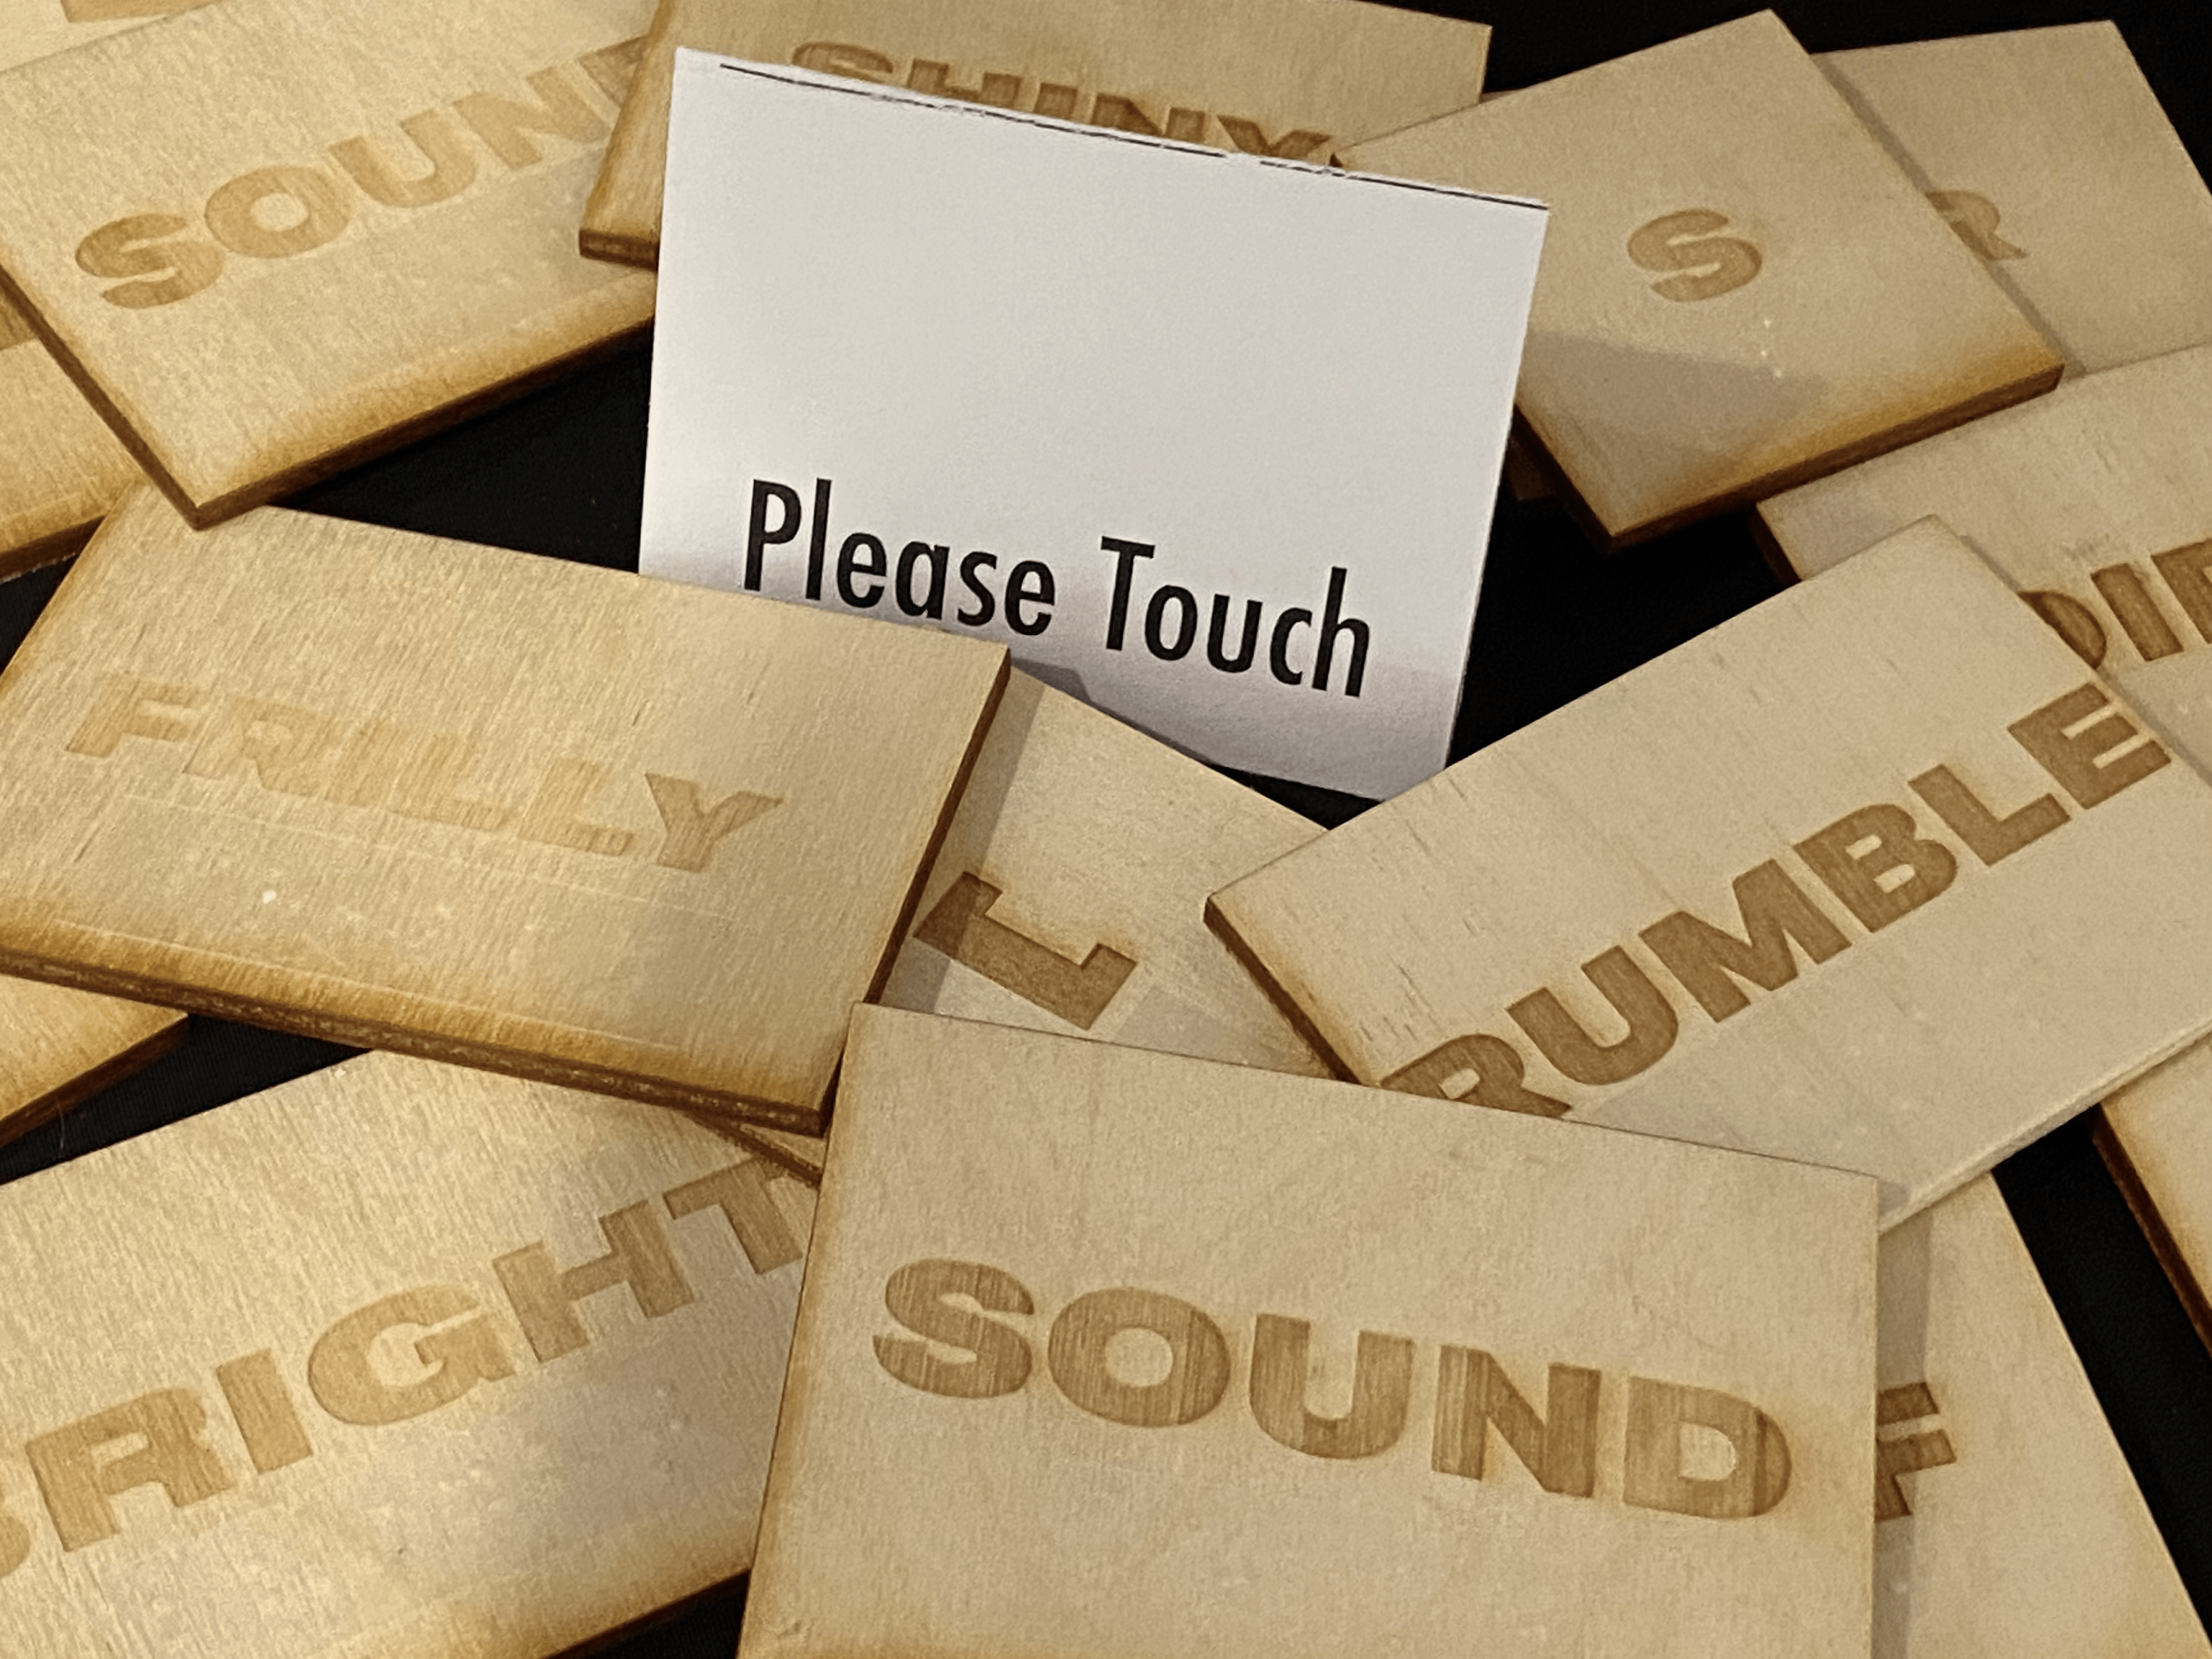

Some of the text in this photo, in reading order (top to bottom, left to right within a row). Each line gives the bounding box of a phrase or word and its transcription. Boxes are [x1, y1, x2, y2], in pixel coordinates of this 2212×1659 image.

[75, 33, 651, 309] SOUN
[744, 478, 1370, 698] Please Touch
[64, 671, 784, 873] FRILLY
[1381, 682, 2172, 1120] RUMBLE
[0, 1157, 803, 1580] RIGHT
[873, 1257, 1792, 1520] SOUND
